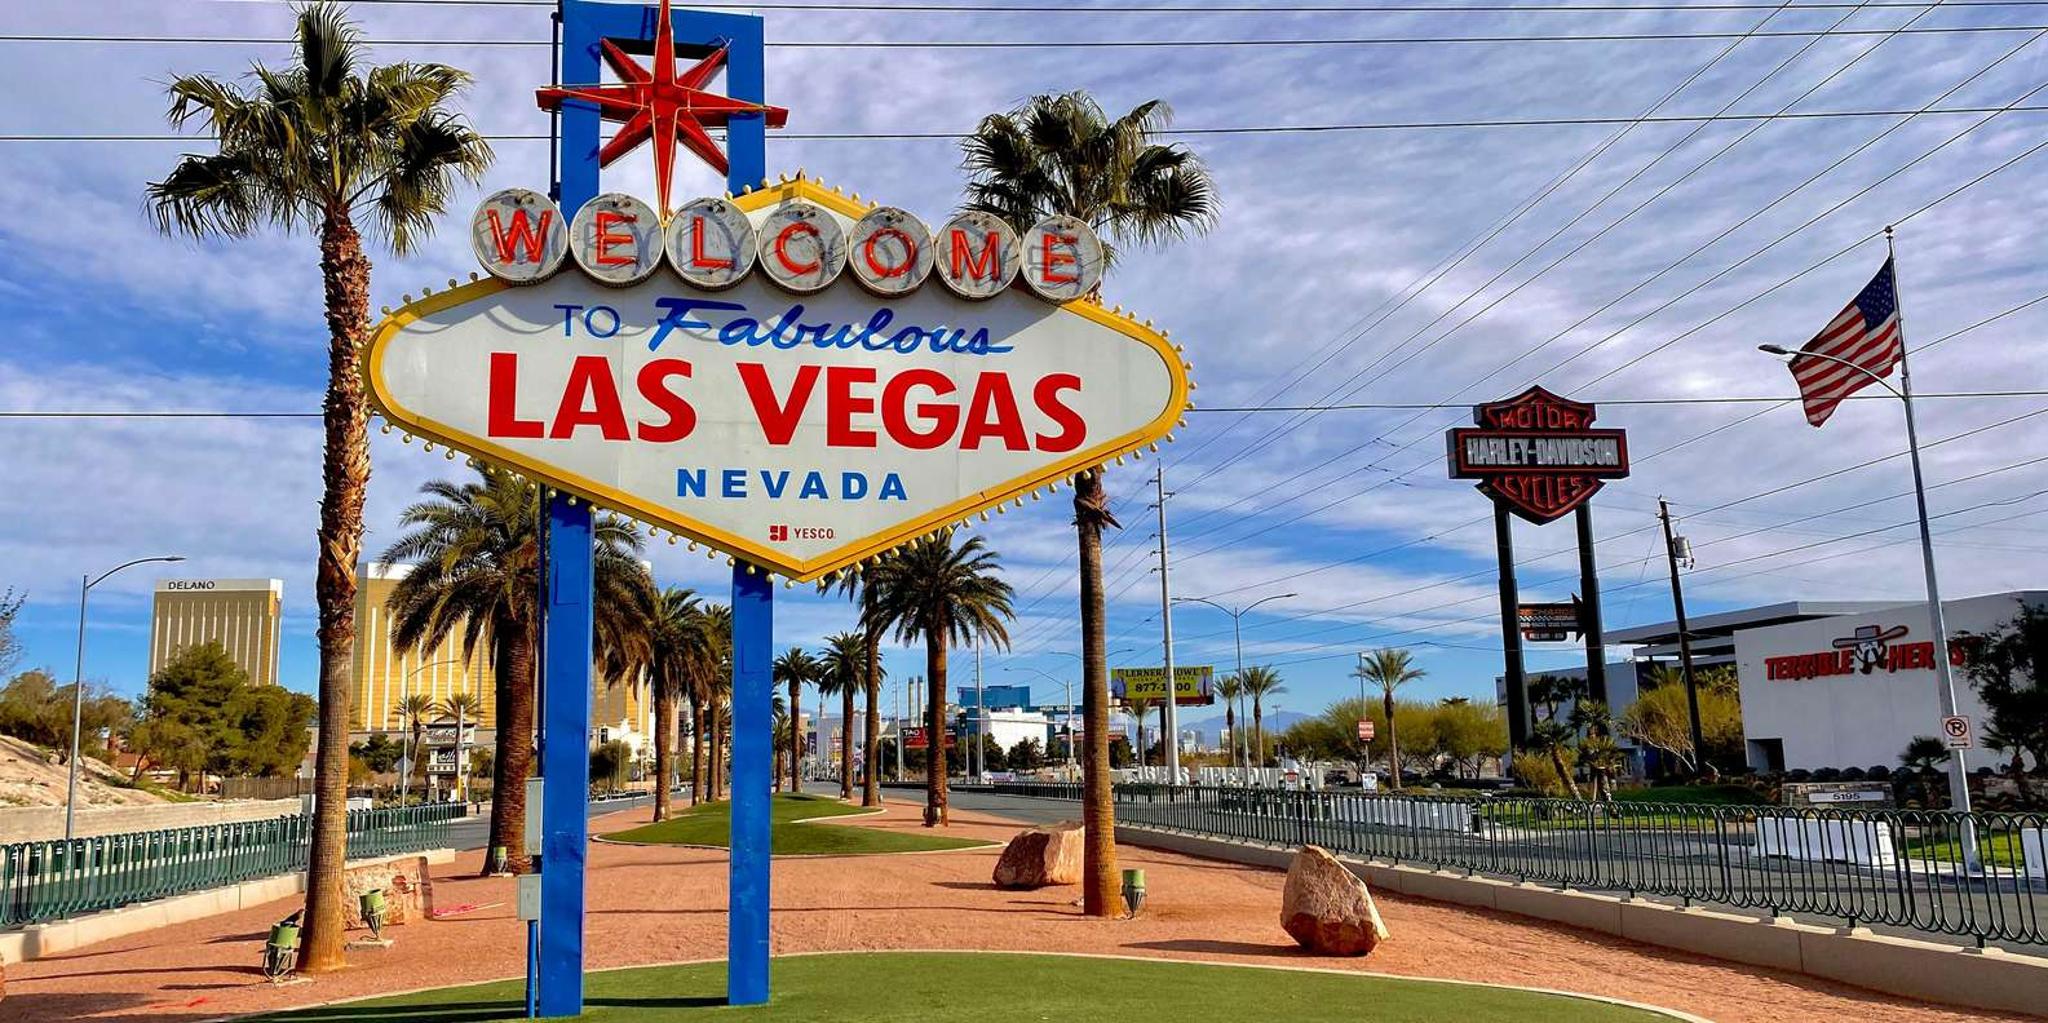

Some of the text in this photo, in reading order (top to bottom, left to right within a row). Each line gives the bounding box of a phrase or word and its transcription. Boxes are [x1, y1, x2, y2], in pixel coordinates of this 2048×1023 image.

[487, 208, 1078, 282] WELCOME
[554, 297, 1014, 355] TO Fabulous
[487, 352, 1087, 452] LAS VEGAS
[1500, 402, 1580, 429] MOTOR
[1466, 437, 1619, 466] HARLEY-DAVIDSON
[676, 468, 908, 501] NEVADA
[1504, 475, 1583, 509] CYCLES
[168, 580, 216, 590] DELANO
[1765, 648, 1855, 681] TERRIBLE
[1135, 682, 1191, 693] 877-100
